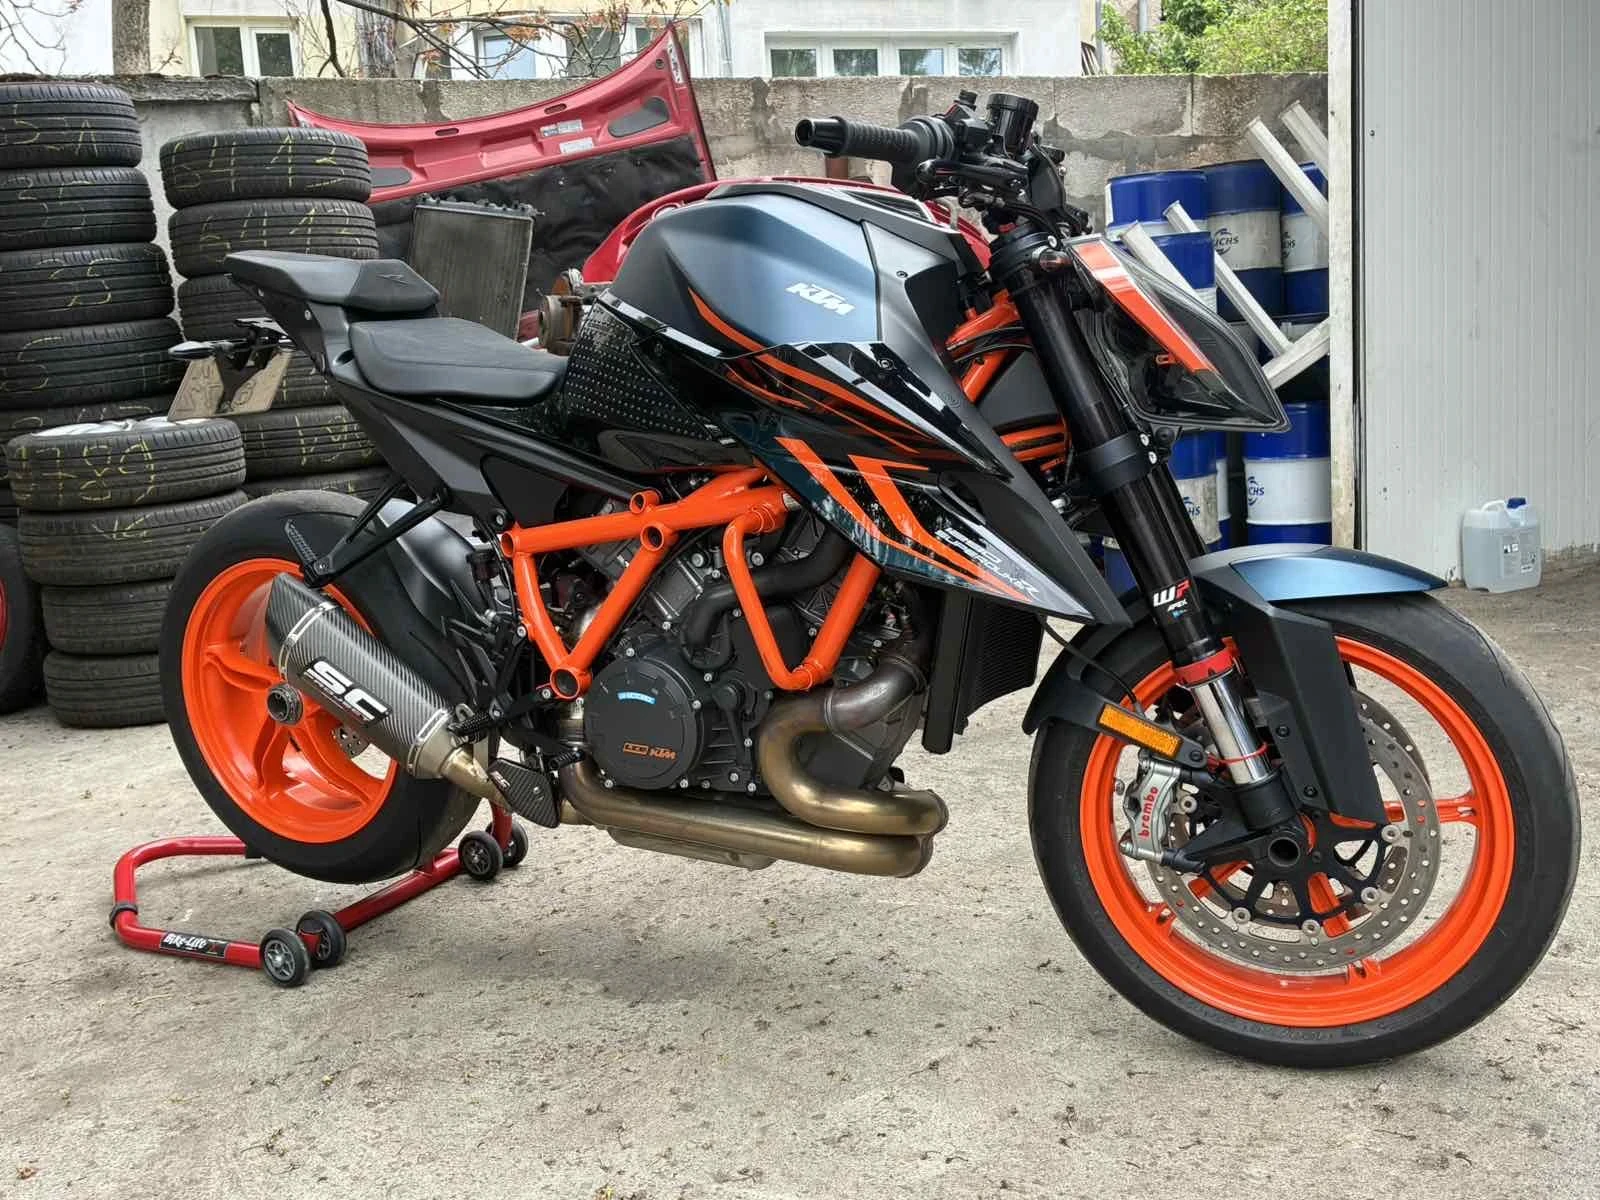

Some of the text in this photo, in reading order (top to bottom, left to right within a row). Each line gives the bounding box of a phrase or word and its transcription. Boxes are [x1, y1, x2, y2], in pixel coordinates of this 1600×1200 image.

[784, 282, 856, 316] KTM
[1152, 578, 1192, 608] WP
[303, 660, 388, 721] SC
[1138, 786, 1159, 840] brembo
